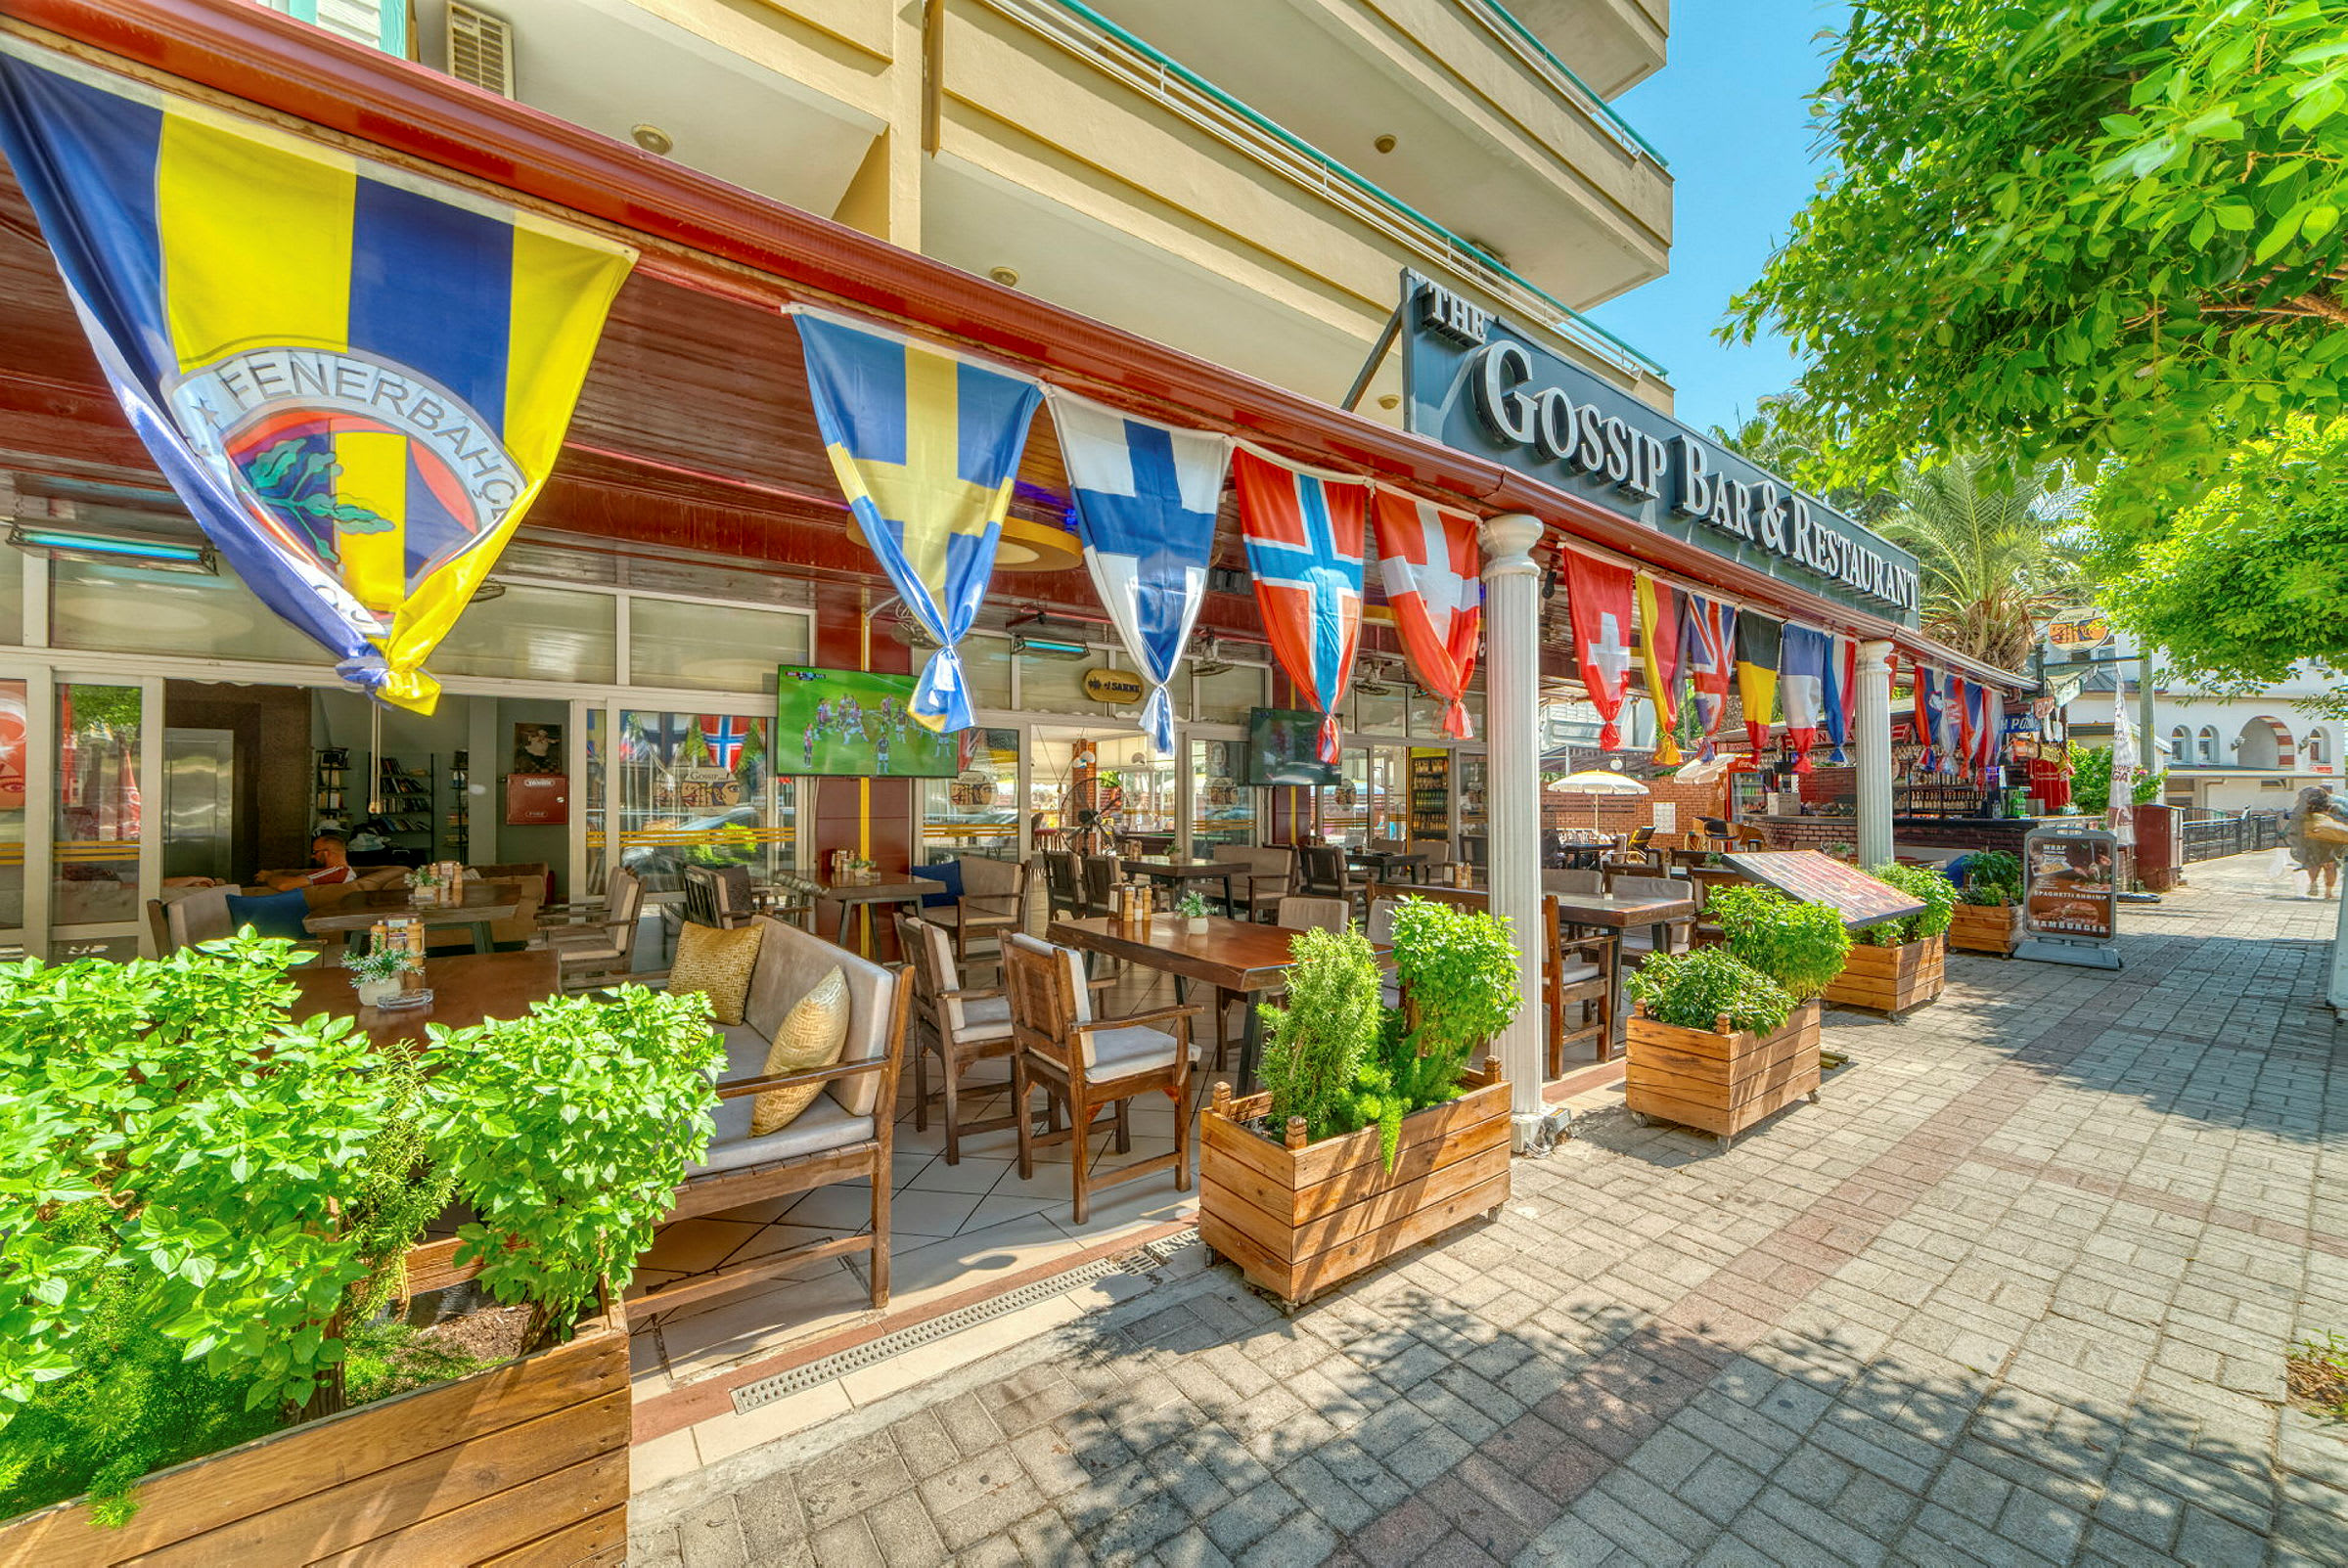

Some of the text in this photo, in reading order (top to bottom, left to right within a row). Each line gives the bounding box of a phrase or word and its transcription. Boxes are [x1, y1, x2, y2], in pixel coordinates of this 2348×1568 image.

[1428, 283, 1486, 344] THE
[1483, 339, 1918, 611] GOSSIP BAR & RESTAURANT
